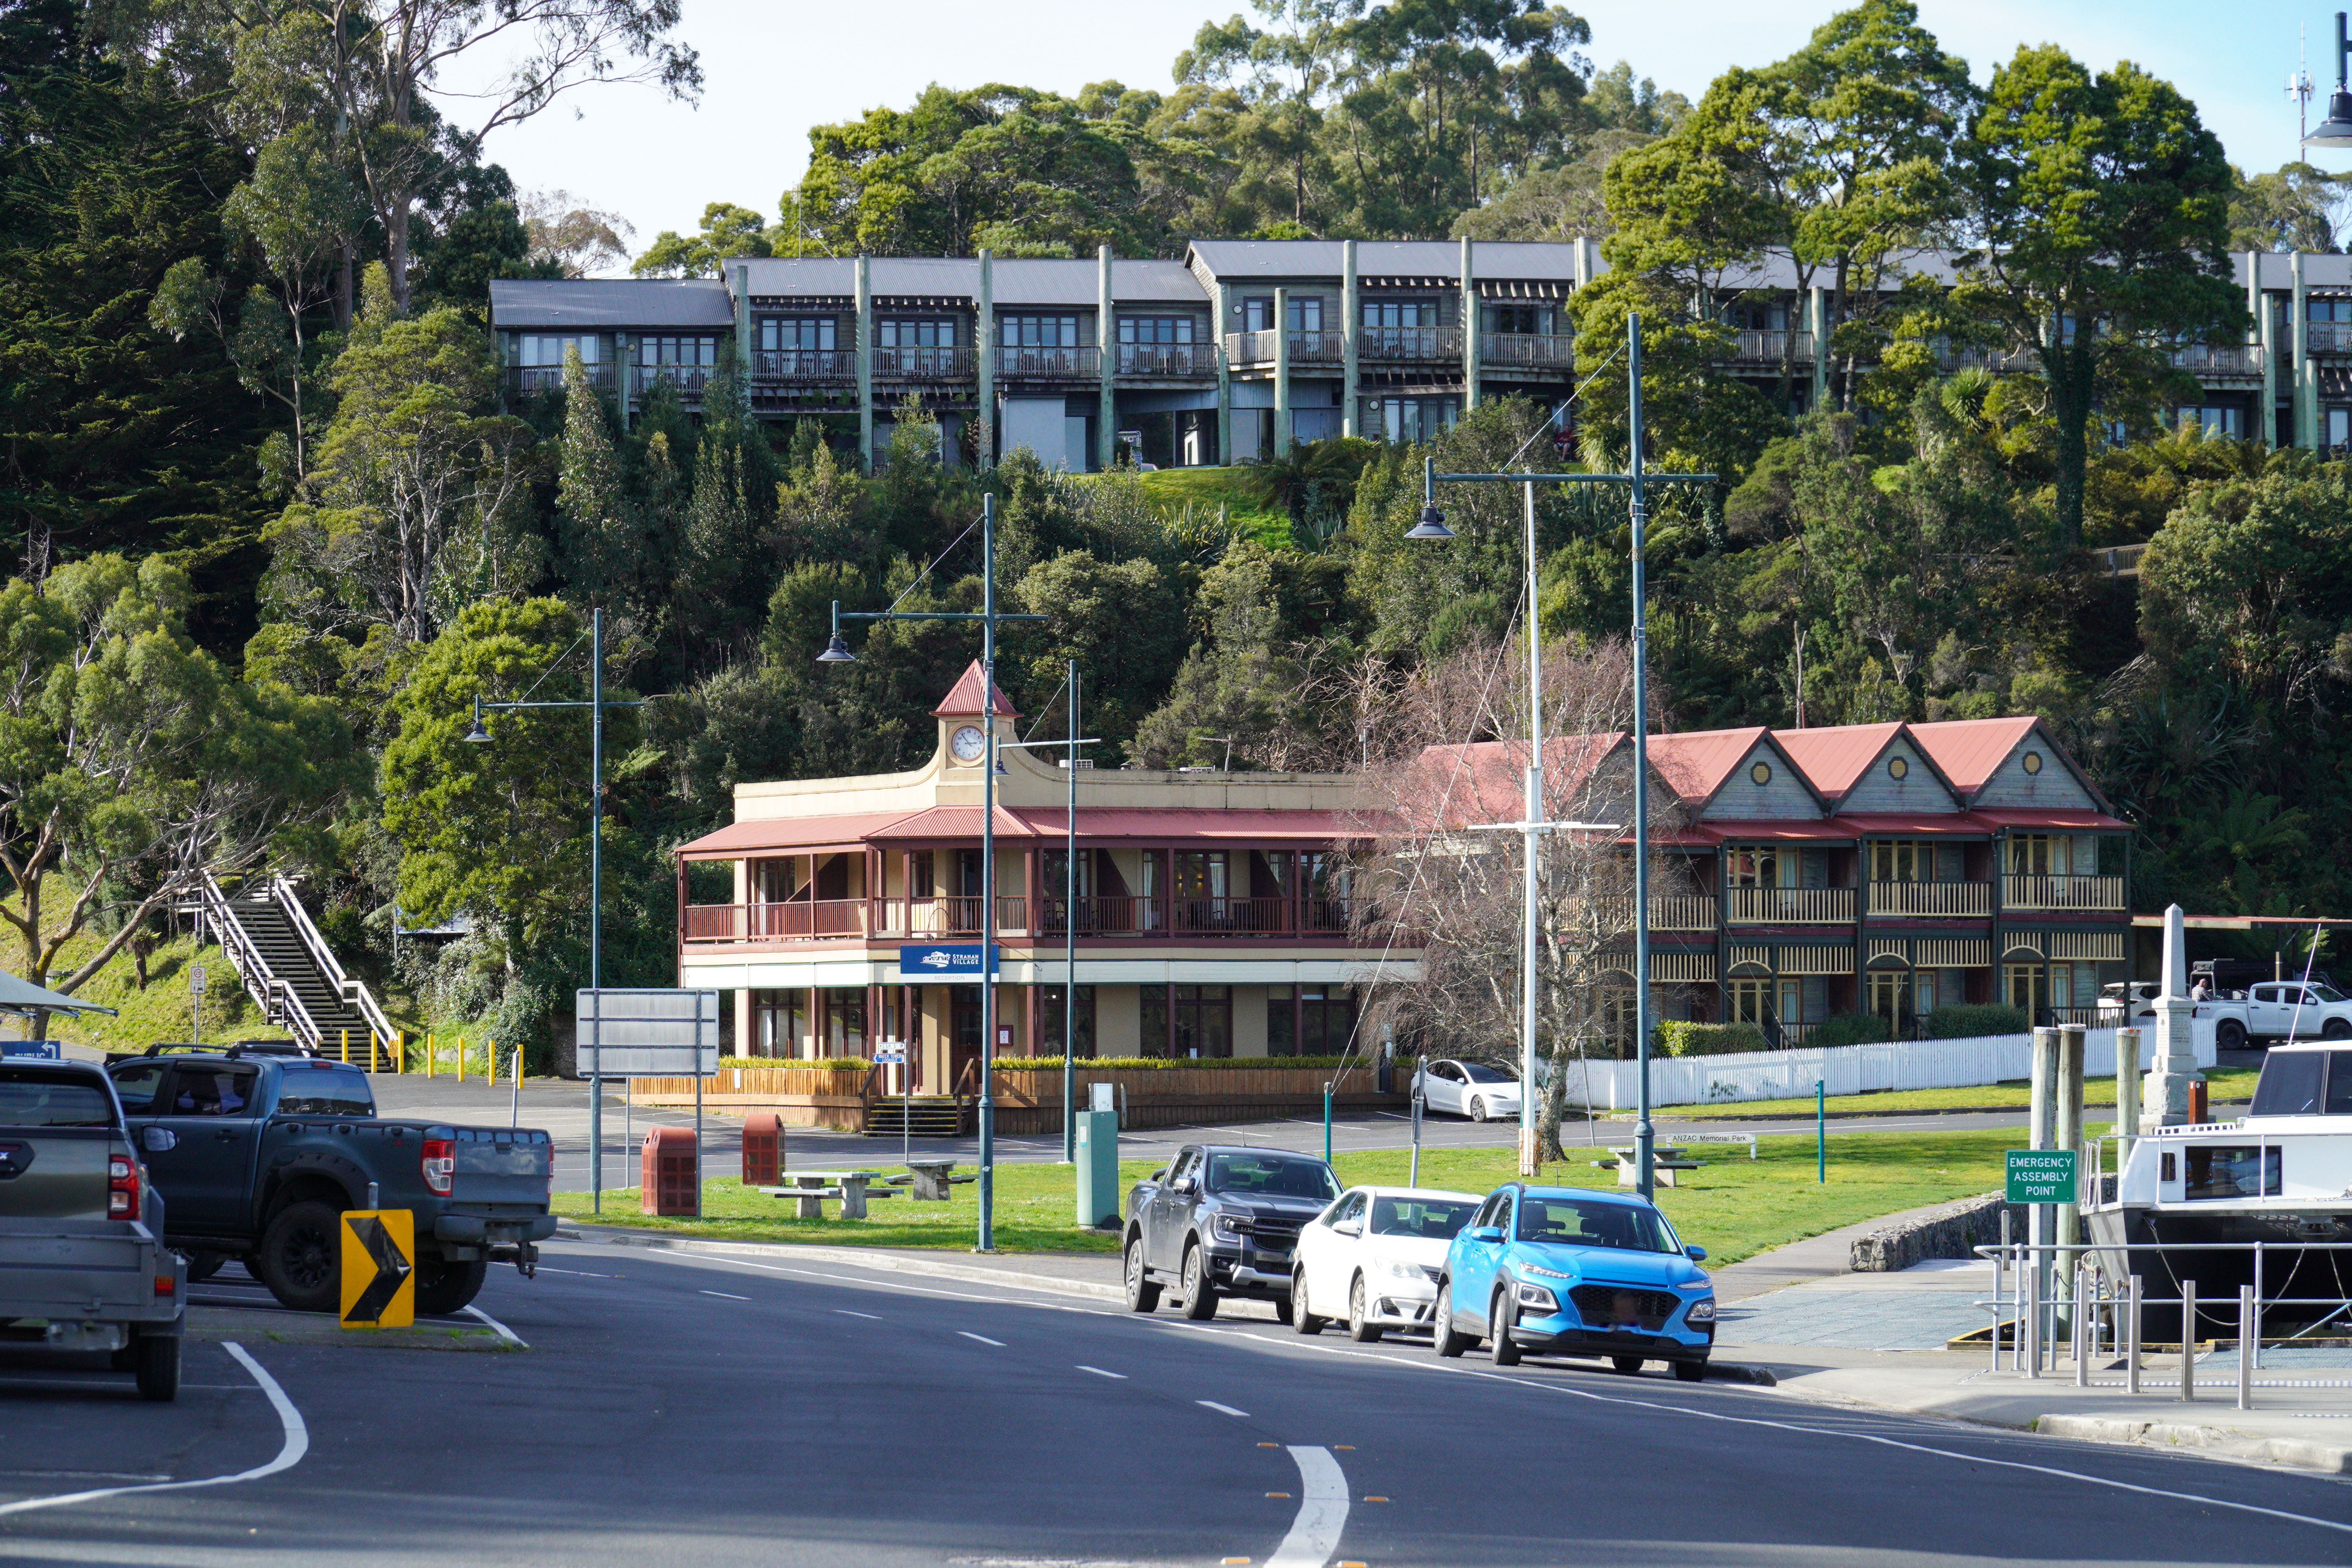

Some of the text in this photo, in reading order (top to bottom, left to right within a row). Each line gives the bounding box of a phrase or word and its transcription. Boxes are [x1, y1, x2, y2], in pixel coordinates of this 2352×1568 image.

[2010, 1158, 2072, 1167] EMERGENCY
[2014, 1172, 2068, 1181] ASSEMBLY
[2026, 1186, 2056, 1196] POINT
